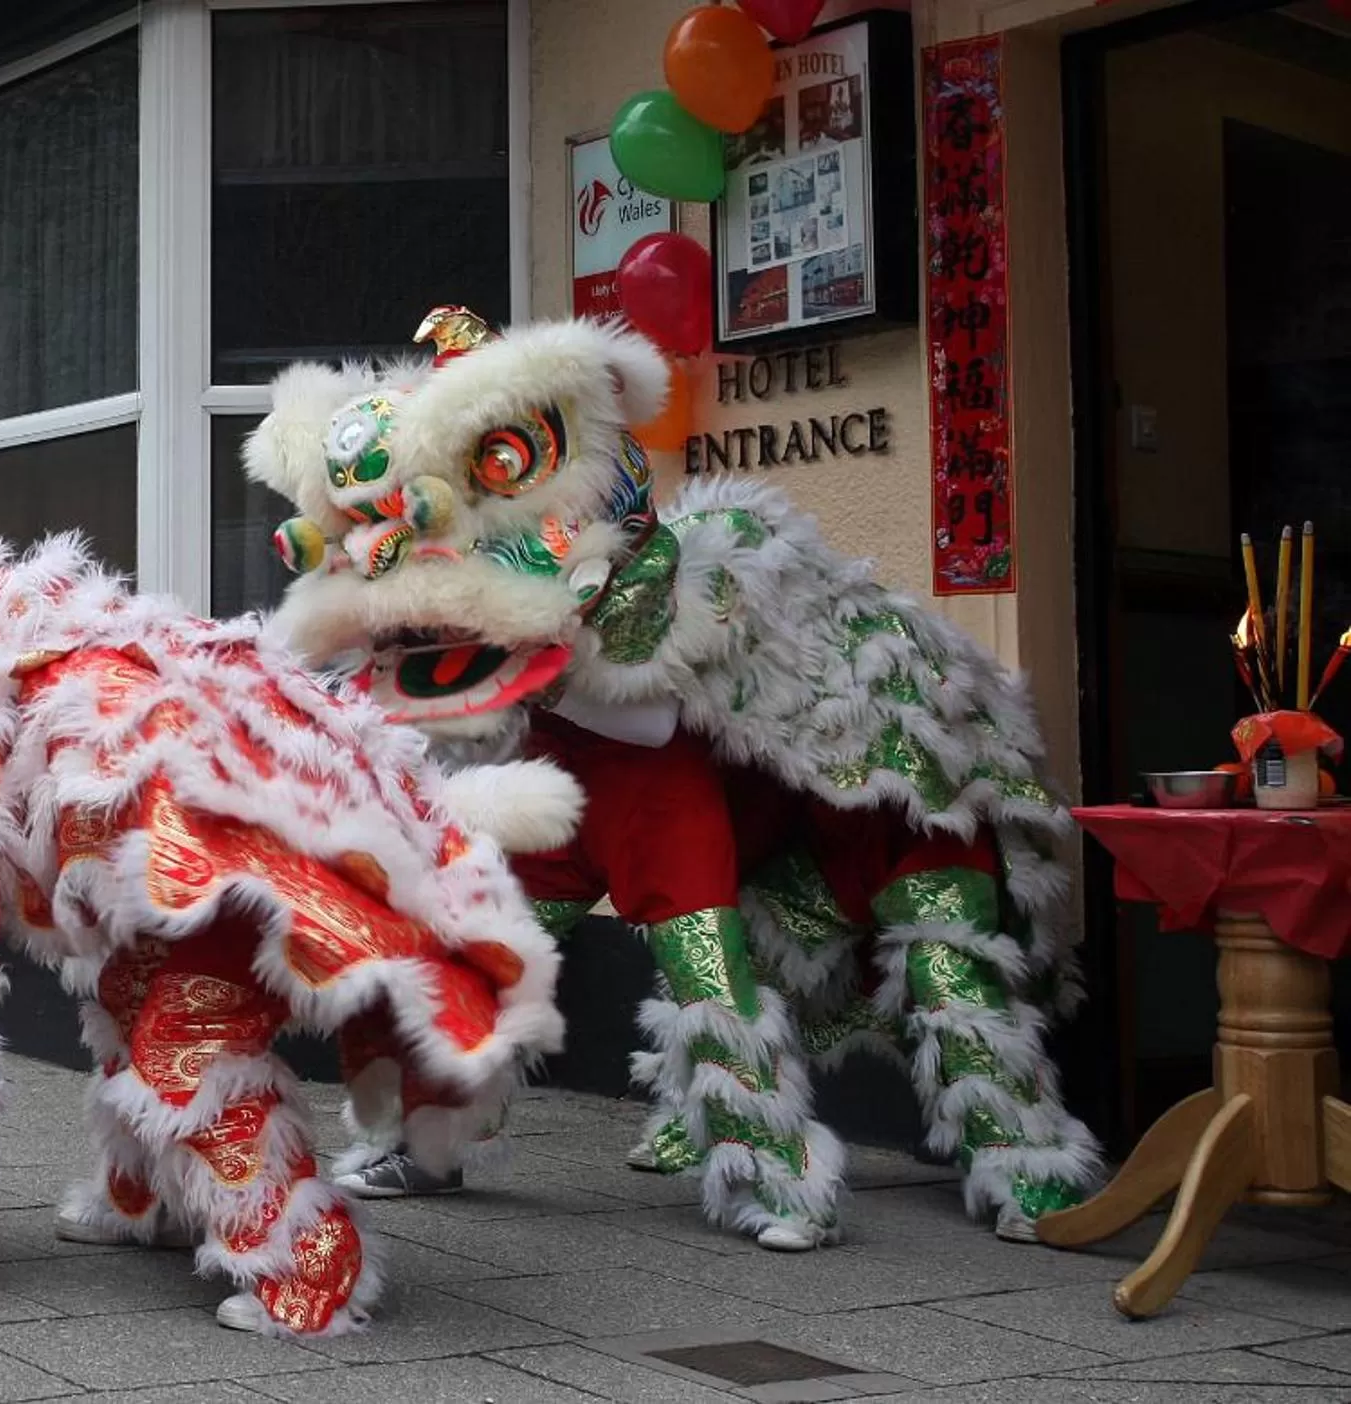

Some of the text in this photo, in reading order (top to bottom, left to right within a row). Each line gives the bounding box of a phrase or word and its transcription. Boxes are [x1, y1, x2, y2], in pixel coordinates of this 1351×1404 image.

[797, 52, 848, 77] HOTEL
[618, 198, 663, 225] Wales
[717, 344, 846, 402] HOTEL
[684, 407, 889, 475] ENTRANCE
